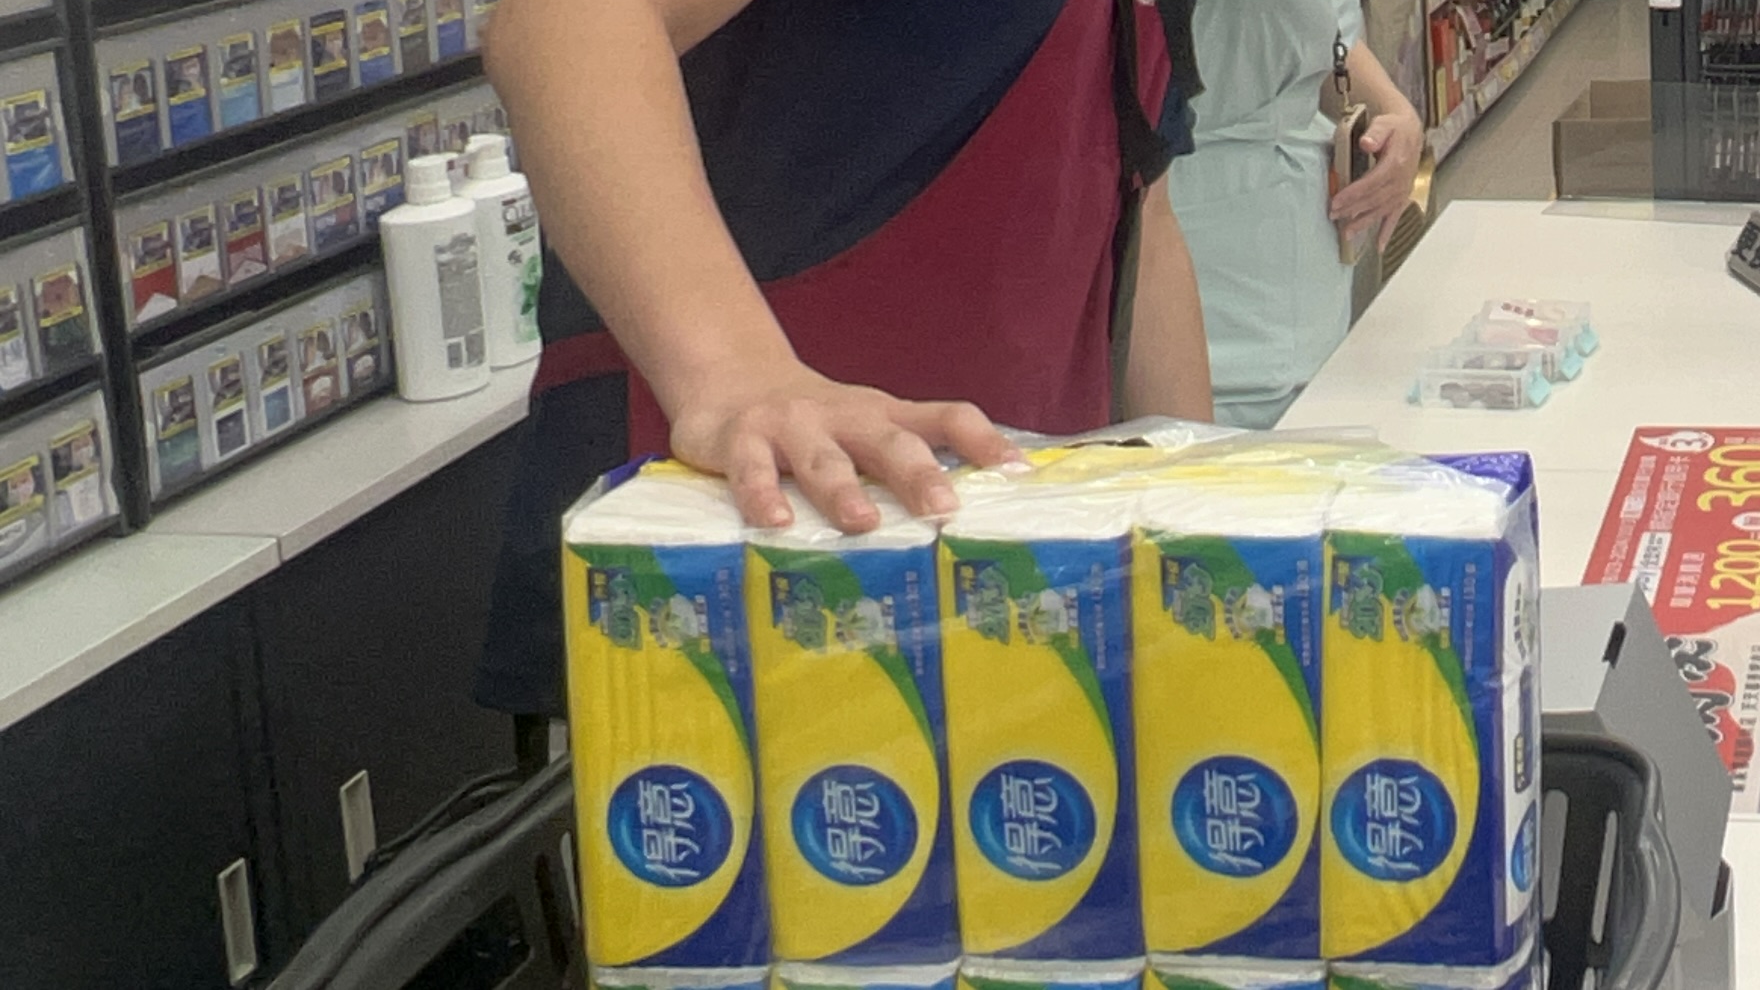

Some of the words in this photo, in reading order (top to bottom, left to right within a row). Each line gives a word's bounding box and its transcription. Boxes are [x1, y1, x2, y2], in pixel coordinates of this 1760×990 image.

[644, 780, 702, 879] 得意
[824, 784, 884, 881] 得意
[1004, 775, 1063, 877] 得意
[1204, 769, 1264, 873] 得意
[1366, 772, 1425, 877] 得意
